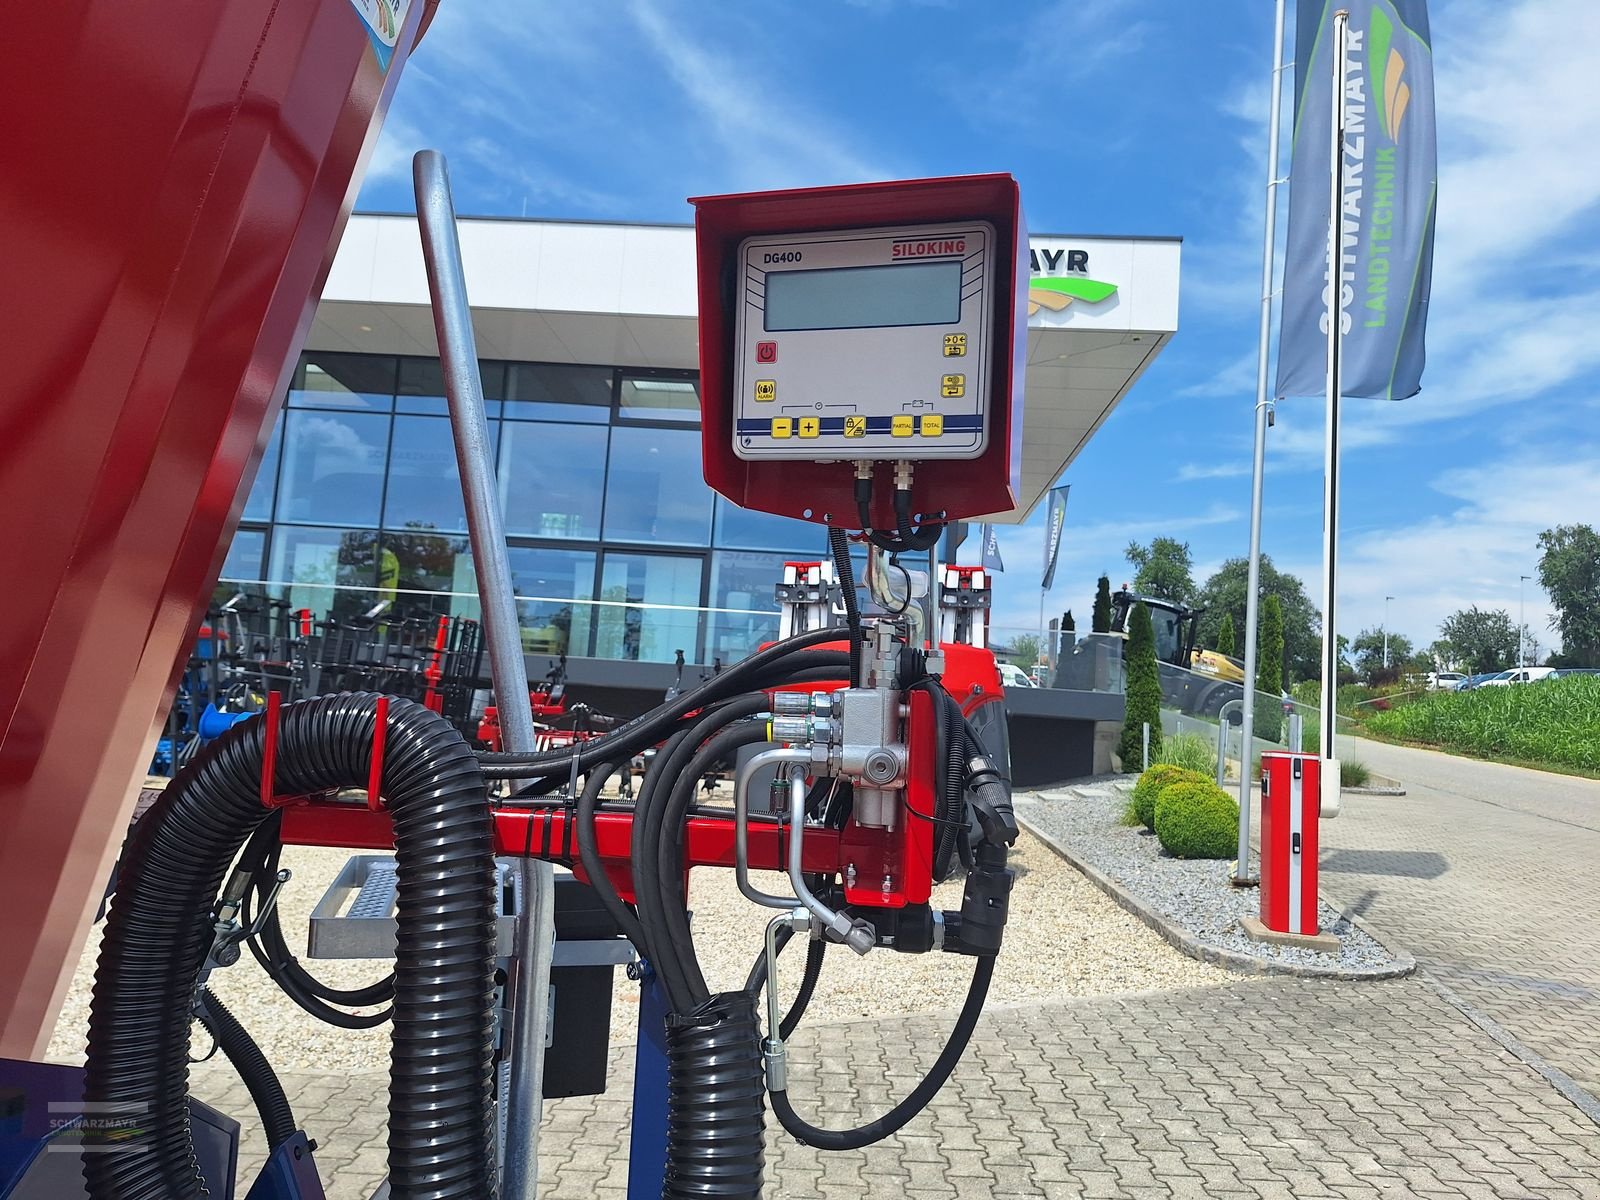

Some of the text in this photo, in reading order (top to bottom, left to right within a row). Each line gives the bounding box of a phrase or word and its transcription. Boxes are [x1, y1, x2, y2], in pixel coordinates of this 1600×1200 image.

[1364, 146, 1397, 329] LANDTECHNIK
[892, 240, 966, 257] SILOKING
[763, 251, 803, 264] DG400
